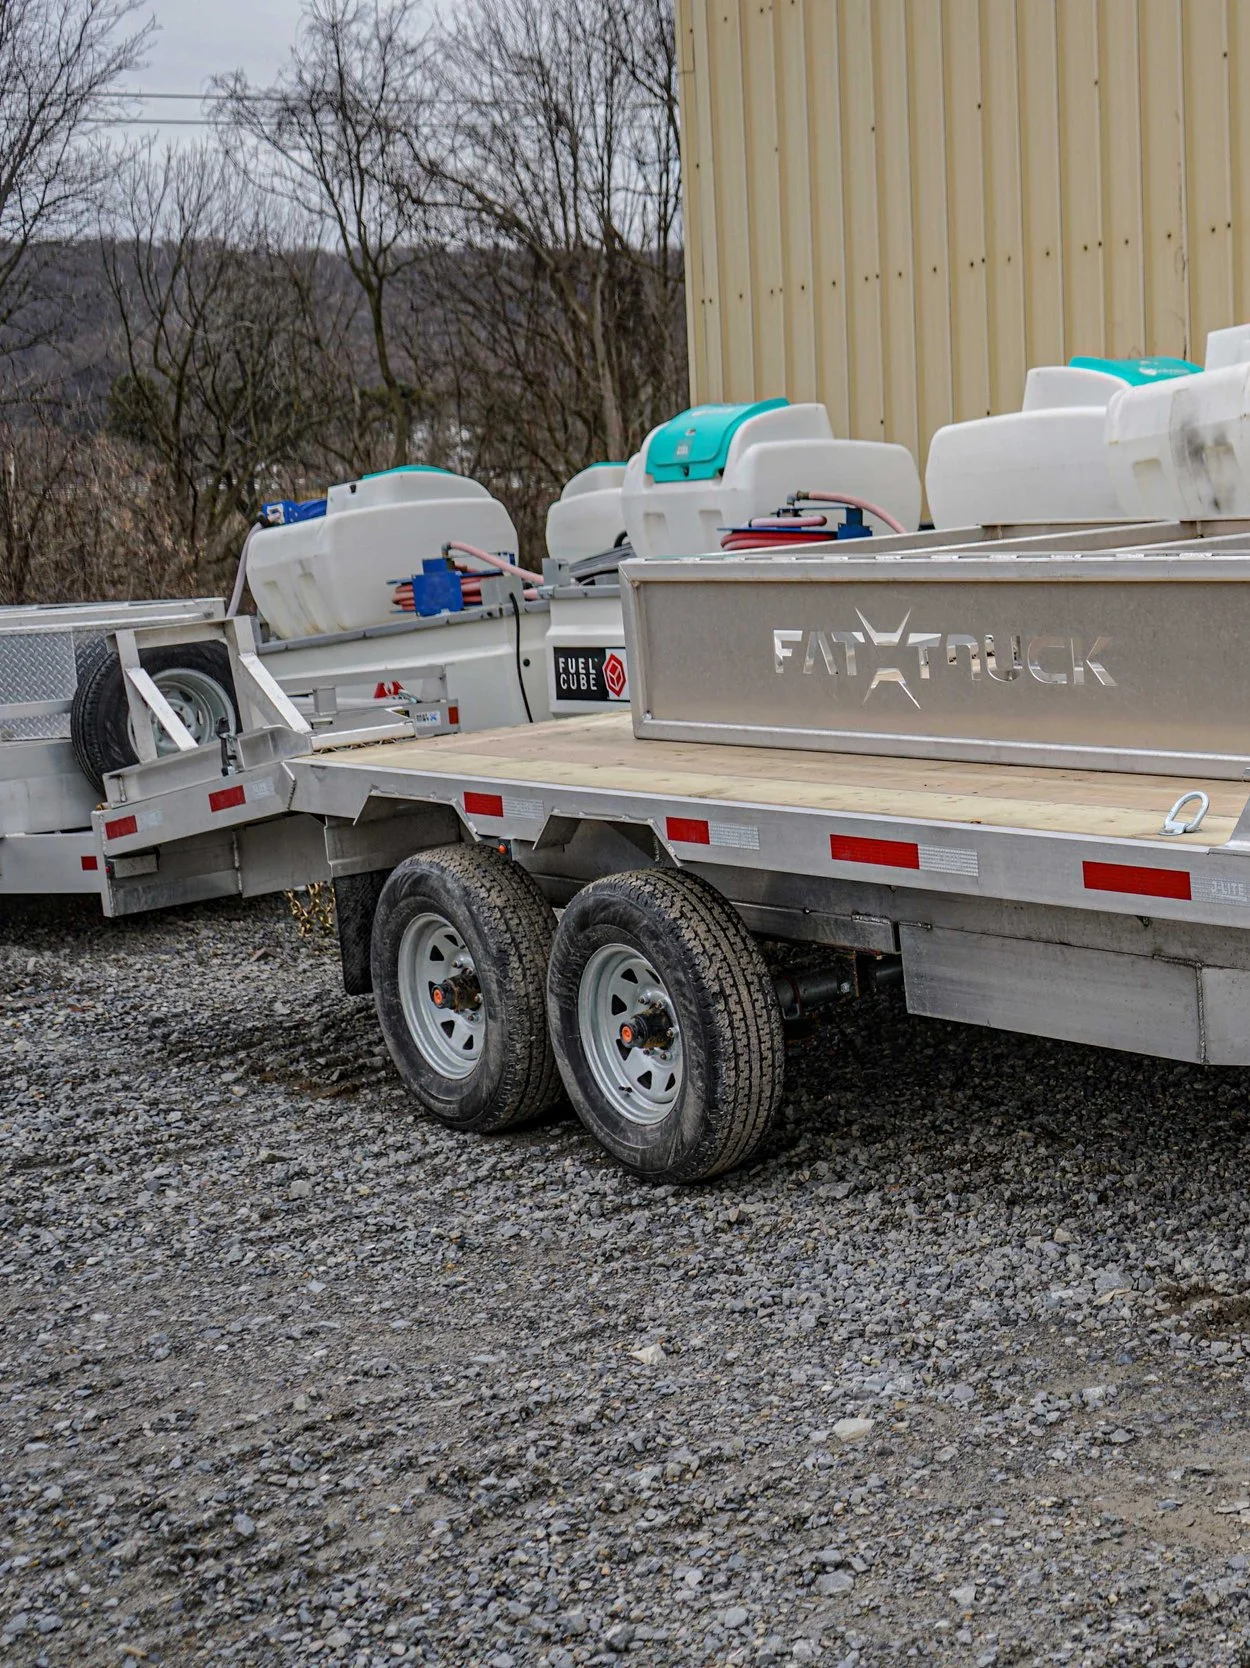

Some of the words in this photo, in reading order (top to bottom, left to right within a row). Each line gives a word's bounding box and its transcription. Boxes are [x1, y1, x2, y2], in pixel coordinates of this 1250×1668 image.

[558, 657, 596, 674] FUEL
[773, 630, 866, 676] FAT
[905, 633, 1118, 686] TRUCK
[560, 673, 597, 690] CUBE
